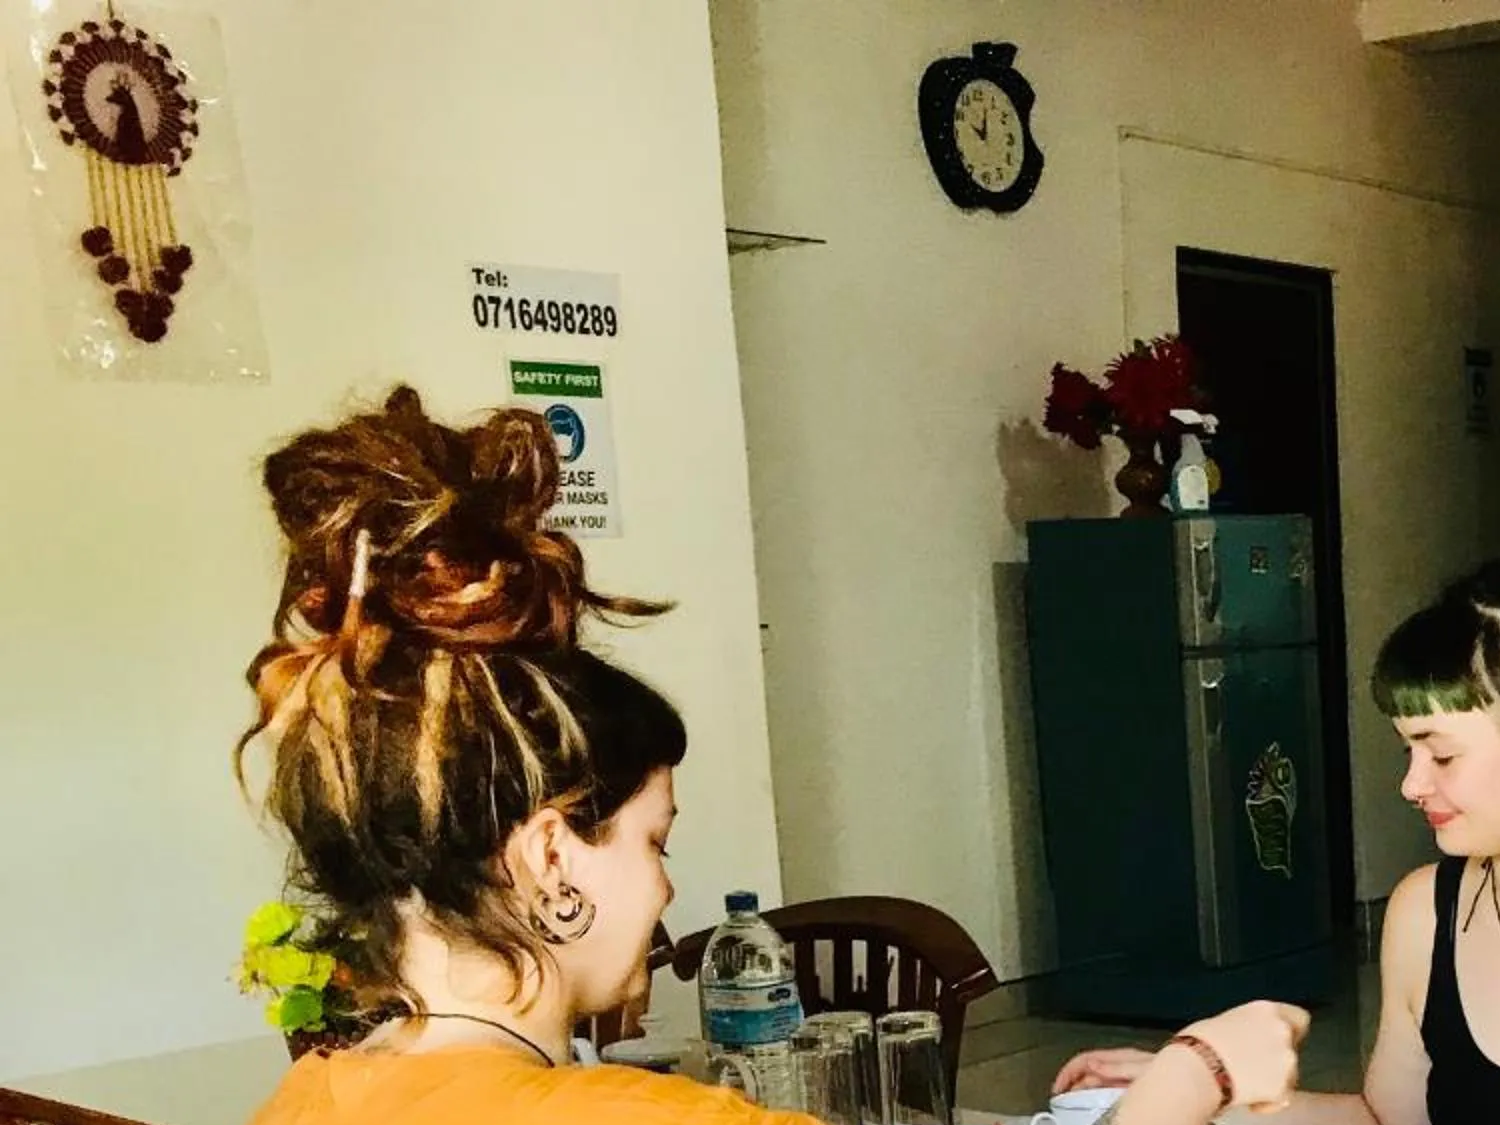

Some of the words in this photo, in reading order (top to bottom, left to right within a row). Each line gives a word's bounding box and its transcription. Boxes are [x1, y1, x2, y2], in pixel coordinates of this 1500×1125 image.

[472, 268, 508, 288] Tel:
[473, 294, 617, 337] 0716498289
[513, 371, 561, 385] SAFETY
[565, 374, 598, 387] FIRST
[567, 491, 608, 505] MASKS
